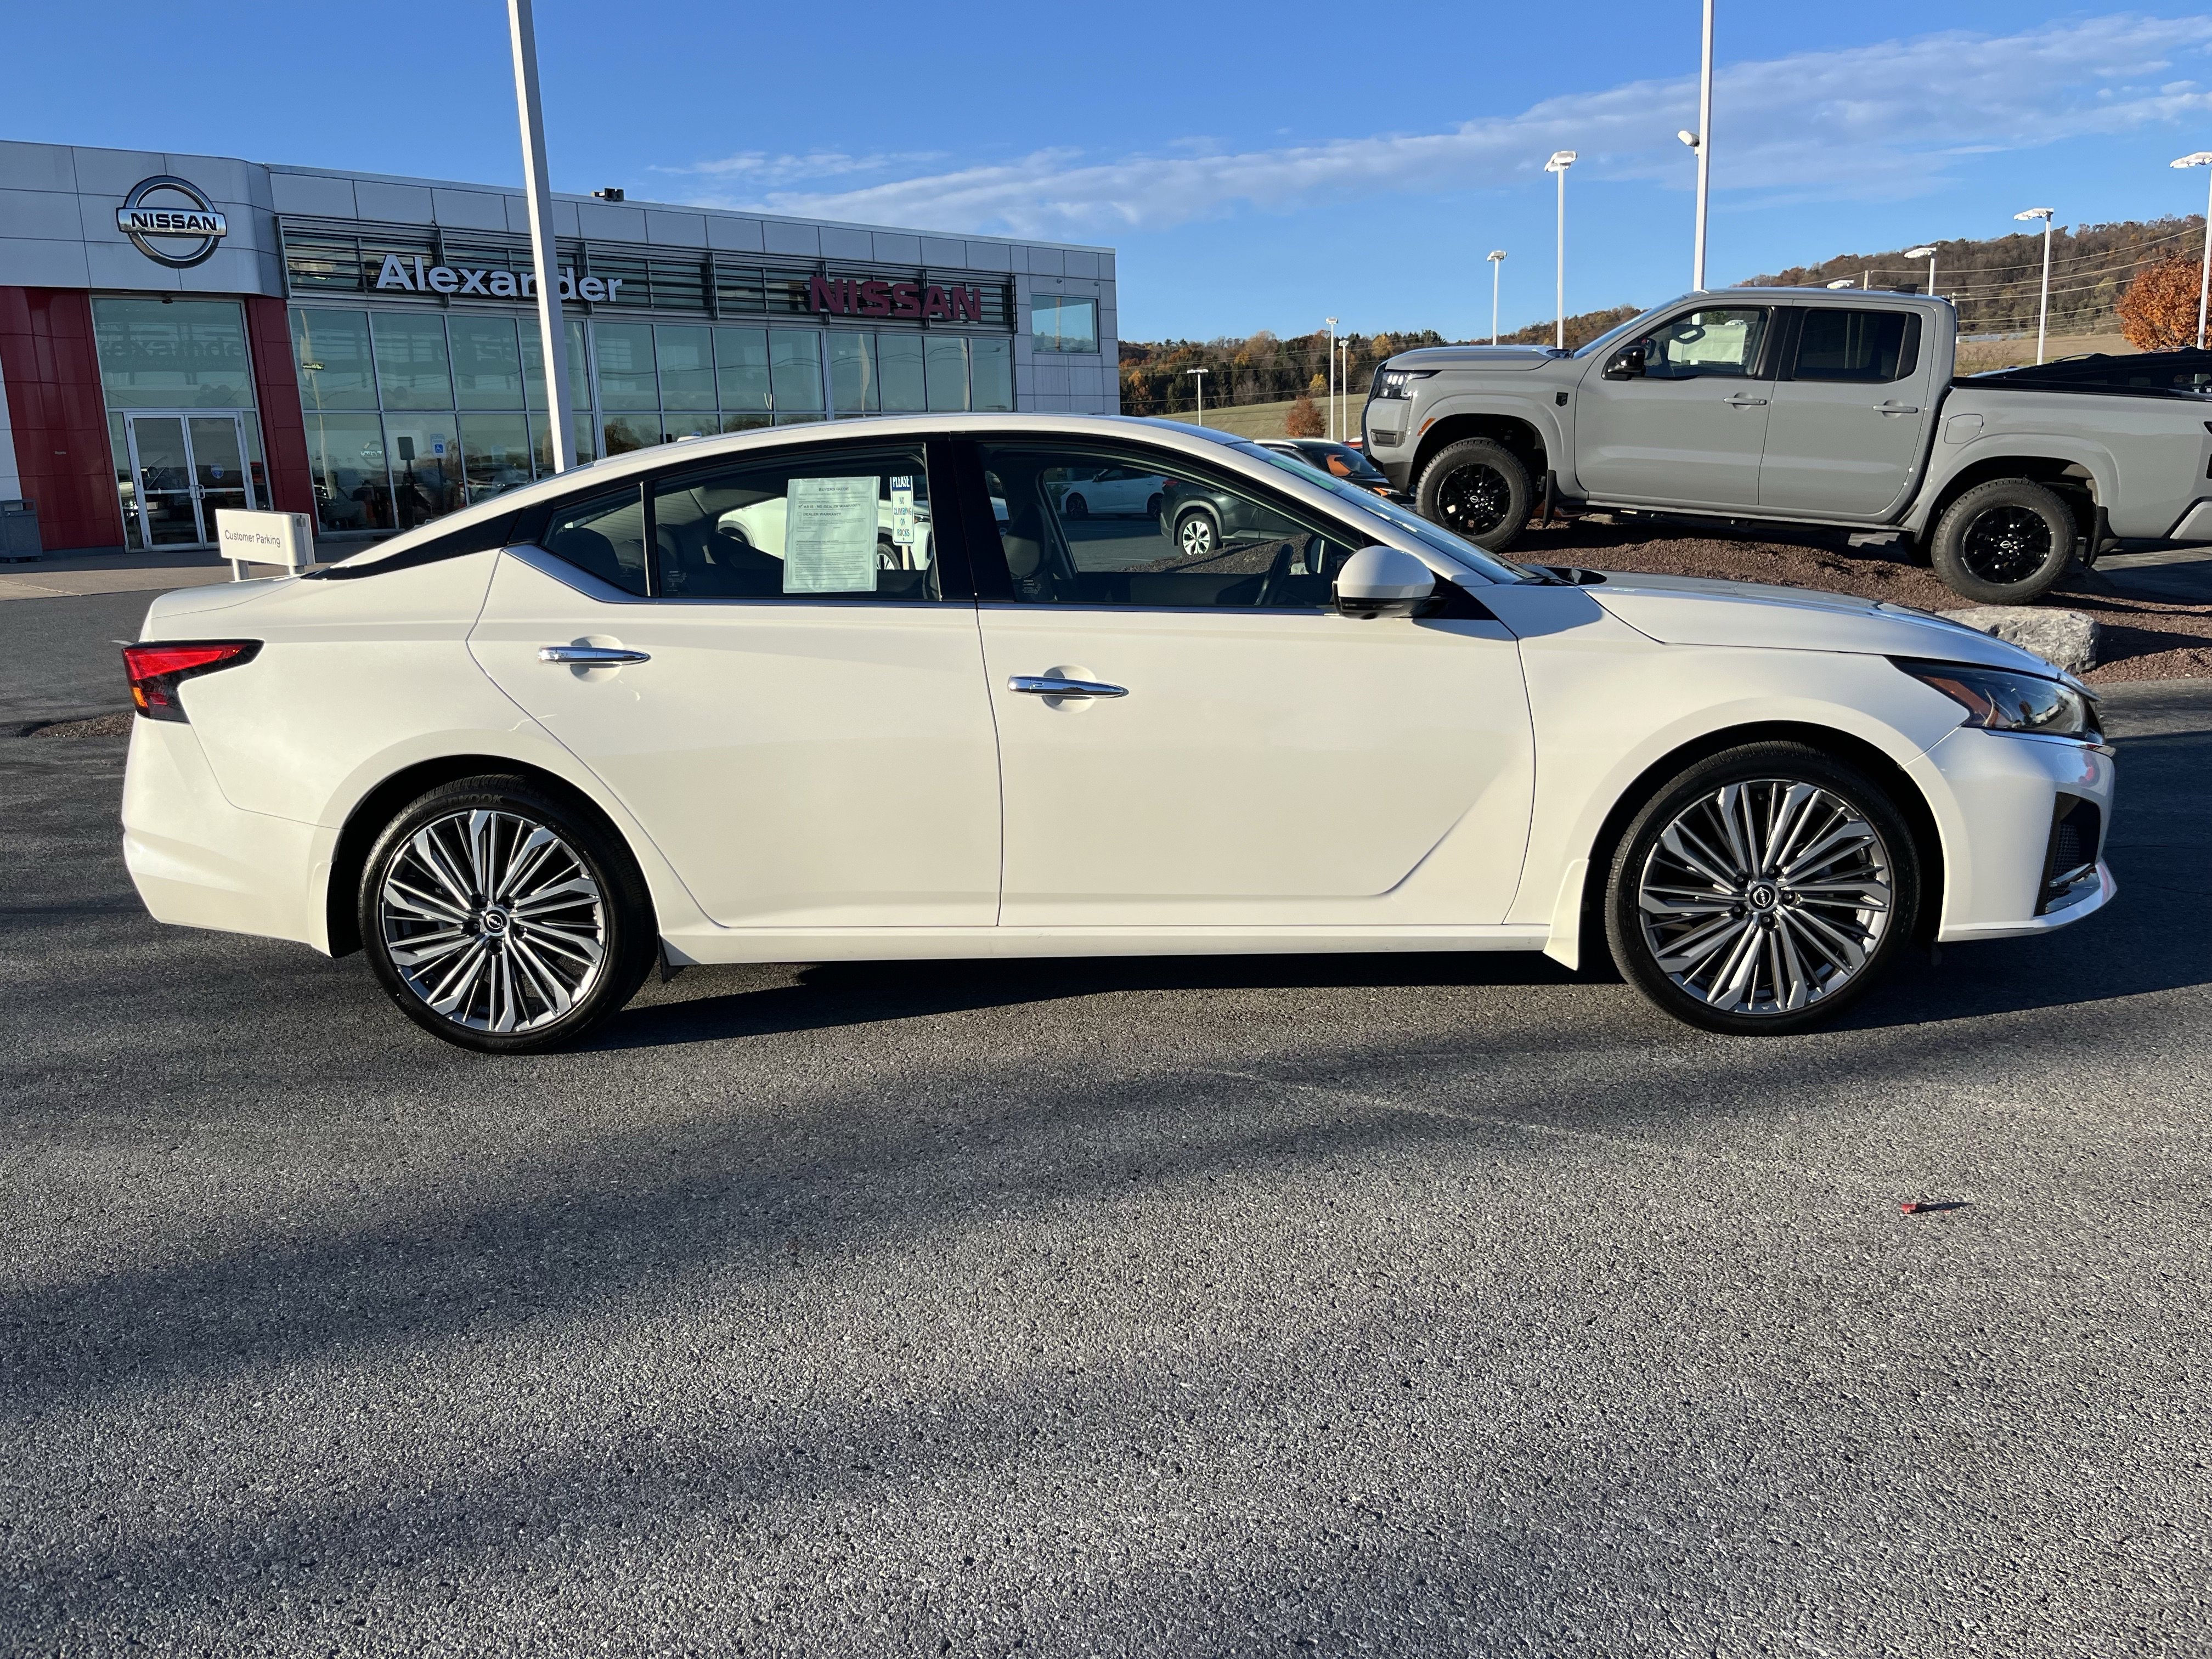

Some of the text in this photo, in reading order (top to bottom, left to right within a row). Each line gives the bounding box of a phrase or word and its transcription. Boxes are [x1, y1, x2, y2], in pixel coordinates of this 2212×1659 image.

[131, 213, 218, 231] NISSAN
[376, 255, 623, 302] Alexander
[809, 276, 981, 321] NISSAN
[893, 476, 910, 488] PLEASE
[894, 507, 912, 515] CLIMBING
[224, 529, 281, 548] Customer Parking
[897, 528, 910, 537] ROCKS
